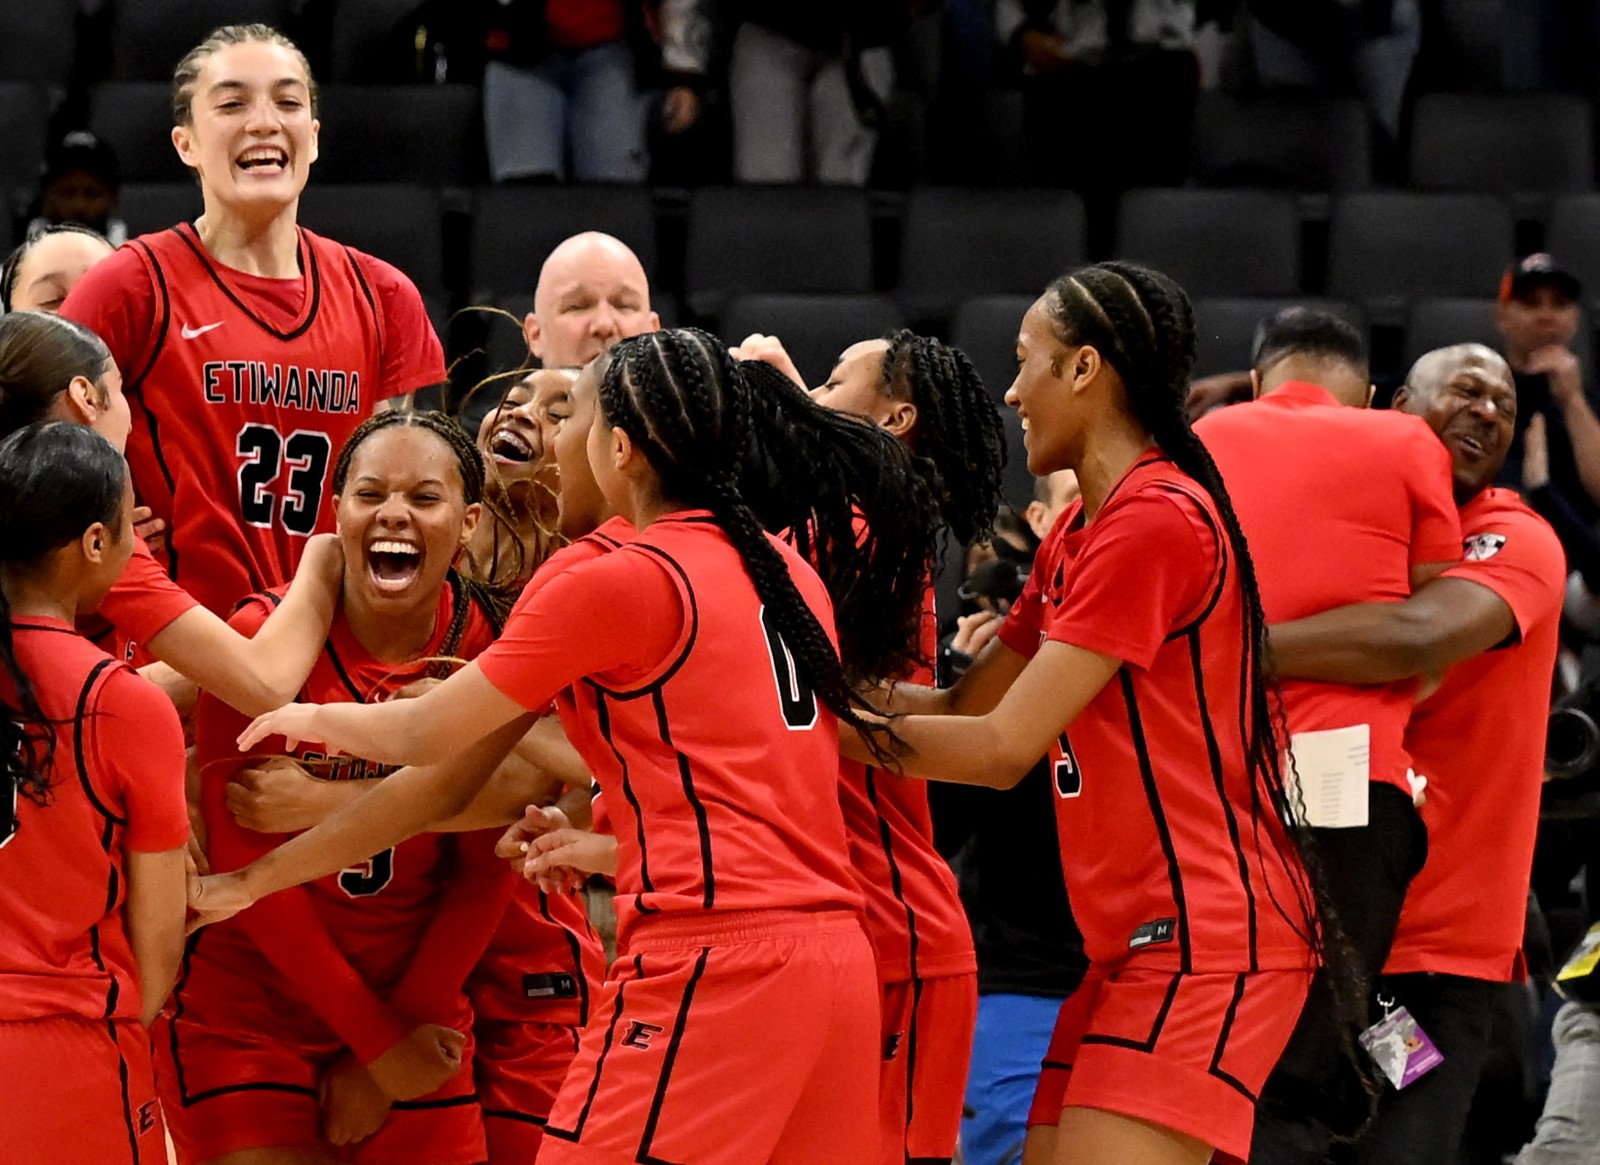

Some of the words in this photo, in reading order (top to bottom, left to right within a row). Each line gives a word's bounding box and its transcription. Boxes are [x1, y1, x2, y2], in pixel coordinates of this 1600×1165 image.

[203, 360, 360, 414] ETIWANDA
[236, 421, 332, 537] 23
[620, 1018, 665, 1052] E
[136, 1097, 157, 1137] E
